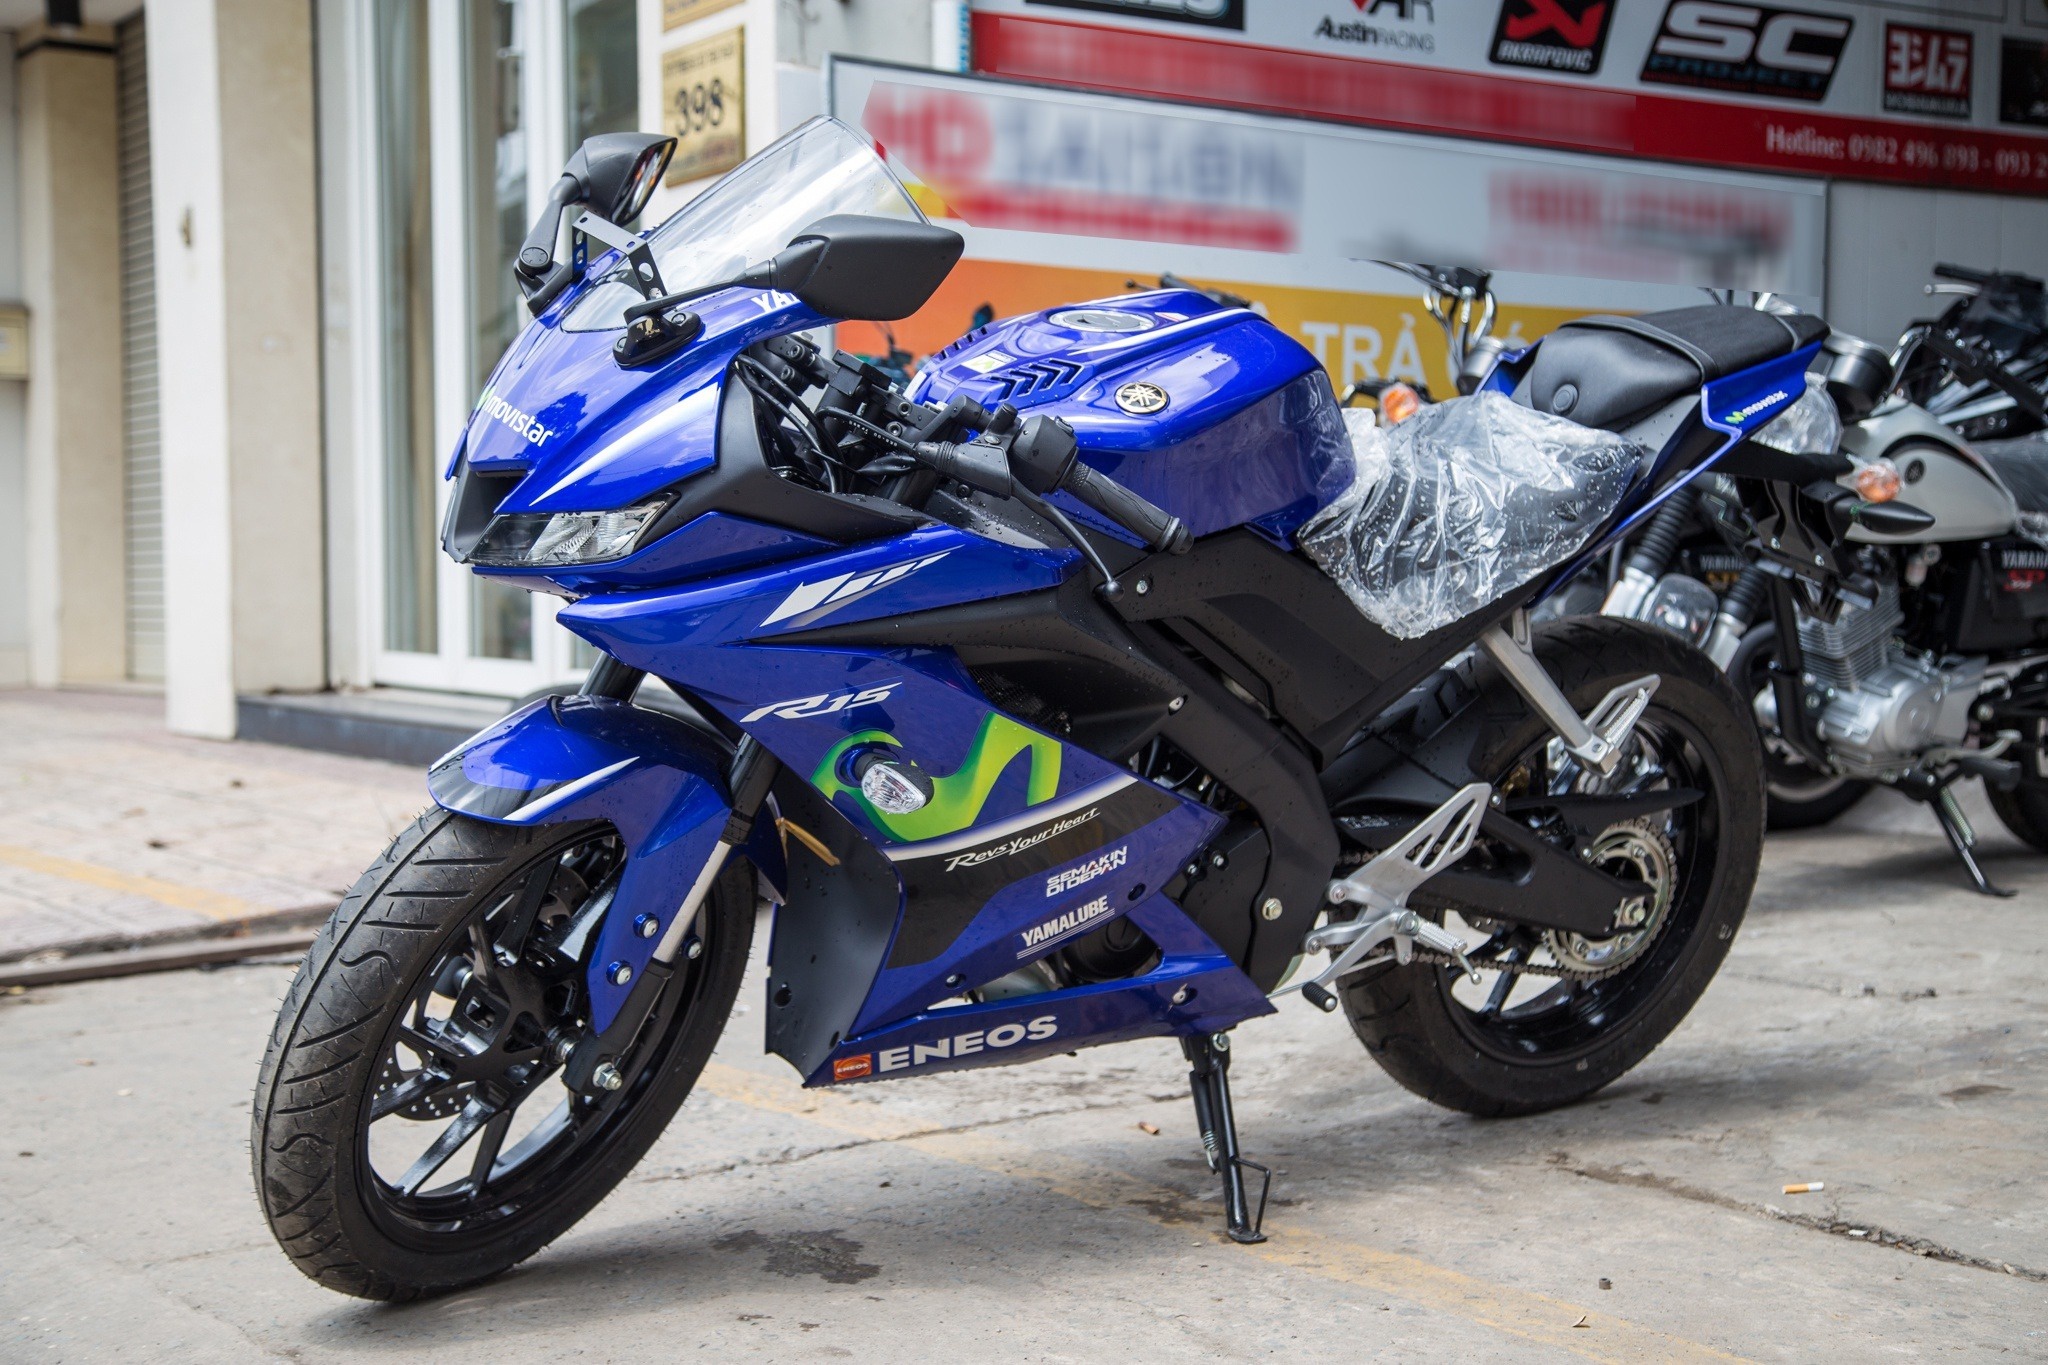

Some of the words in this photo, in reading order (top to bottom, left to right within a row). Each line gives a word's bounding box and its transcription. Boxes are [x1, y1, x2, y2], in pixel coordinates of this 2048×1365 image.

[1656, 1, 1850, 74] SC
[674, 78, 724, 137] 398
[1766, 124, 1845, 160] Hotline:
[484, 395, 554, 447] movistar
[739, 682, 902, 722] R15
[944, 843, 1008, 872] Revs
[1008, 828, 1052, 856] Your
[1051, 807, 1099, 838] Heart
[1046, 845, 1128, 885] SEMAKIN
[1066, 855, 1127, 890] DEPAN
[1021, 895, 1109, 947] YAMALUBE
[836, 1062, 870, 1074] ENEOS
[878, 1015, 1058, 1073] ENEOS
